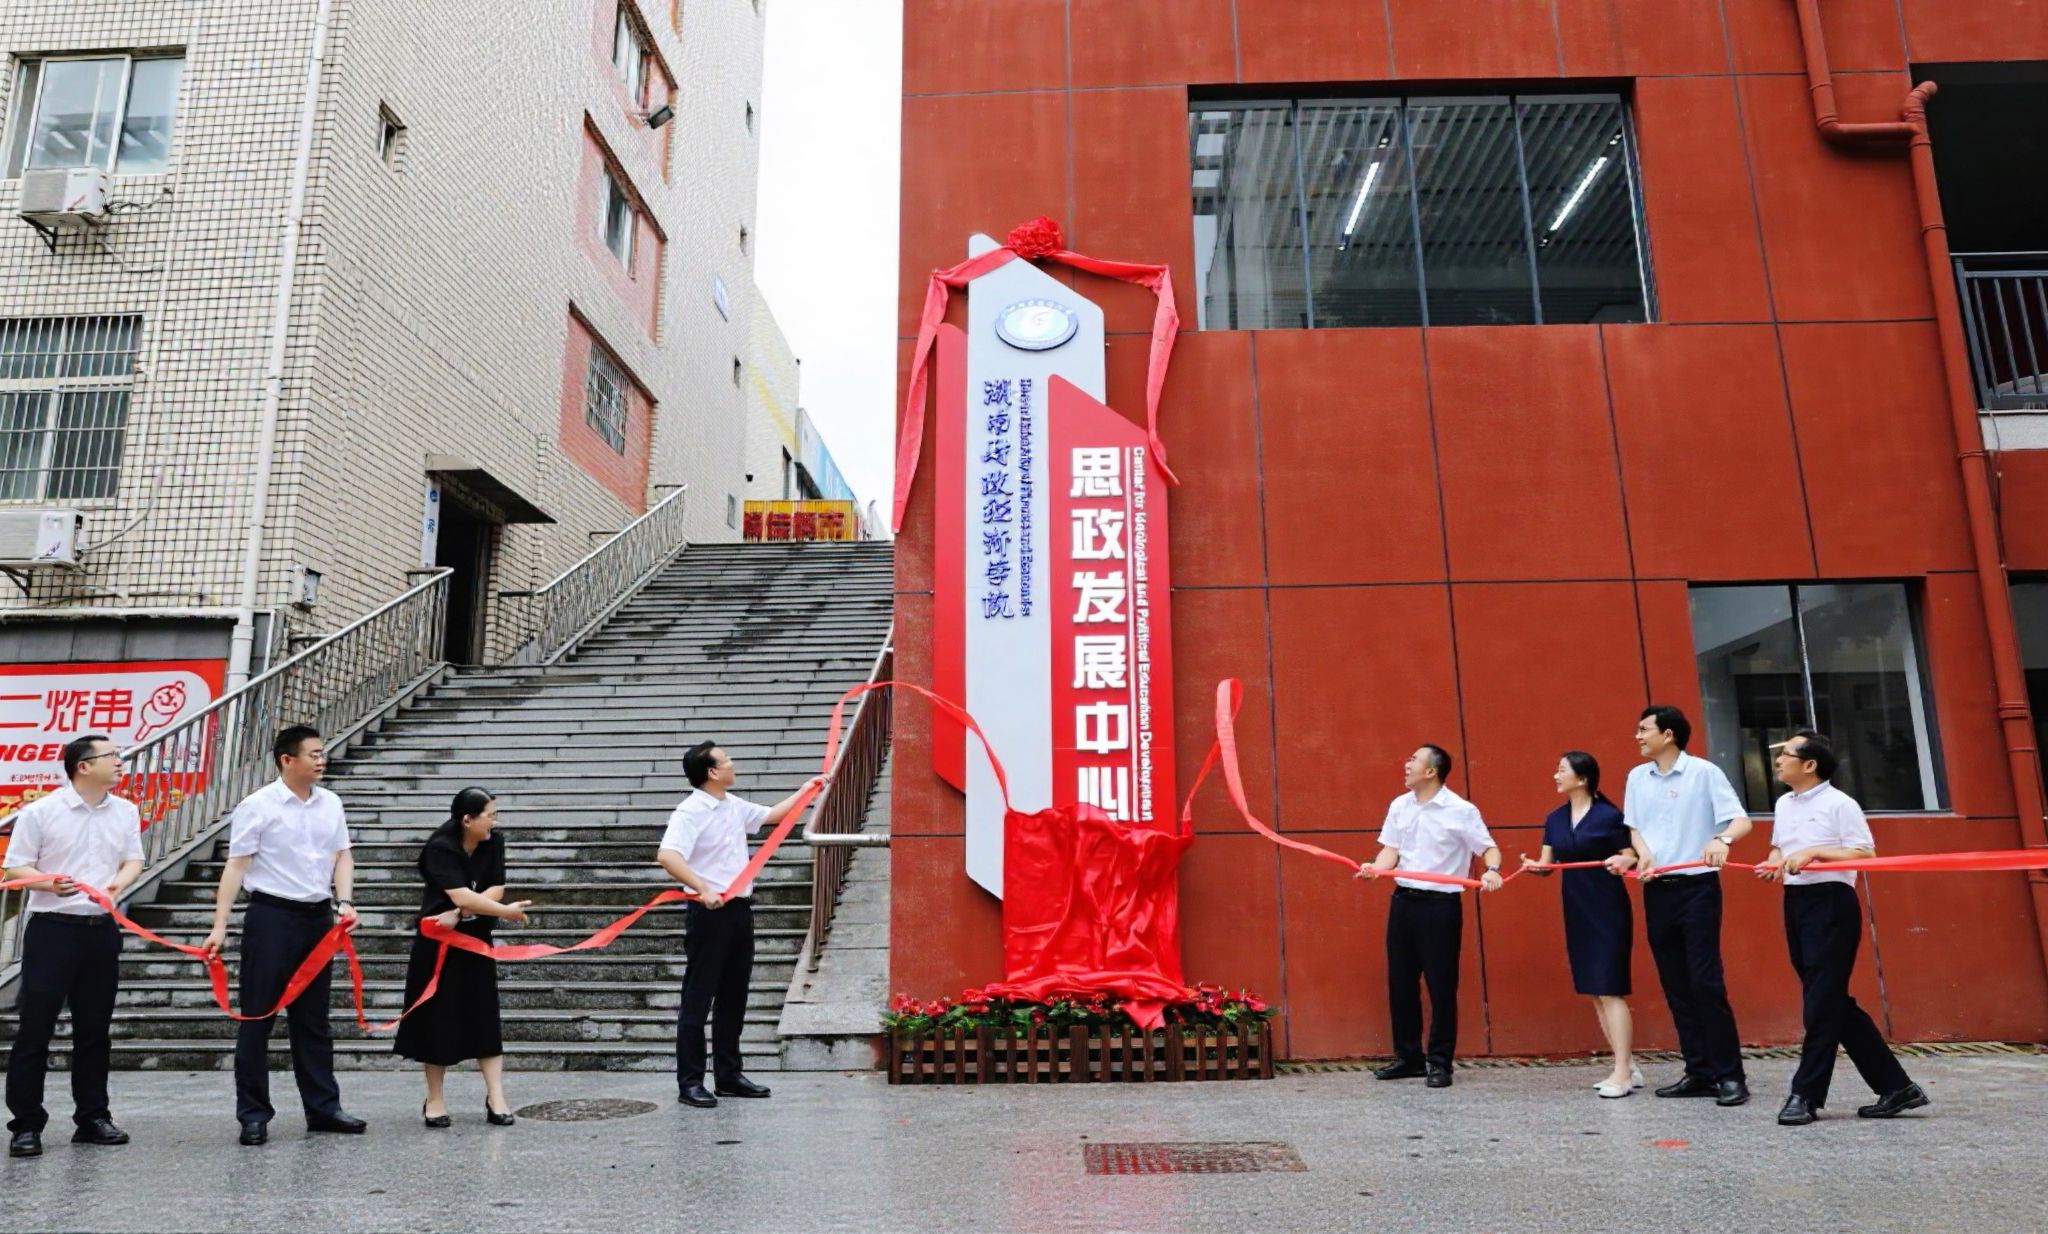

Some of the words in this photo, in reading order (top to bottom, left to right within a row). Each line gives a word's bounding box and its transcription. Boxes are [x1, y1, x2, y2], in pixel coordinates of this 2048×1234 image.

[1133, 446, 1145, 490] Center
[1134, 491, 1144, 509] for
[1134, 512, 1149, 581] Ideological
[1135, 583, 1148, 606] and
[1070, 446, 1130, 822] 思政发展中心
[1136, 609, 1150, 662] Political
[1138, 662, 1151, 730] Education
[1140, 732, 1154, 822] Development
